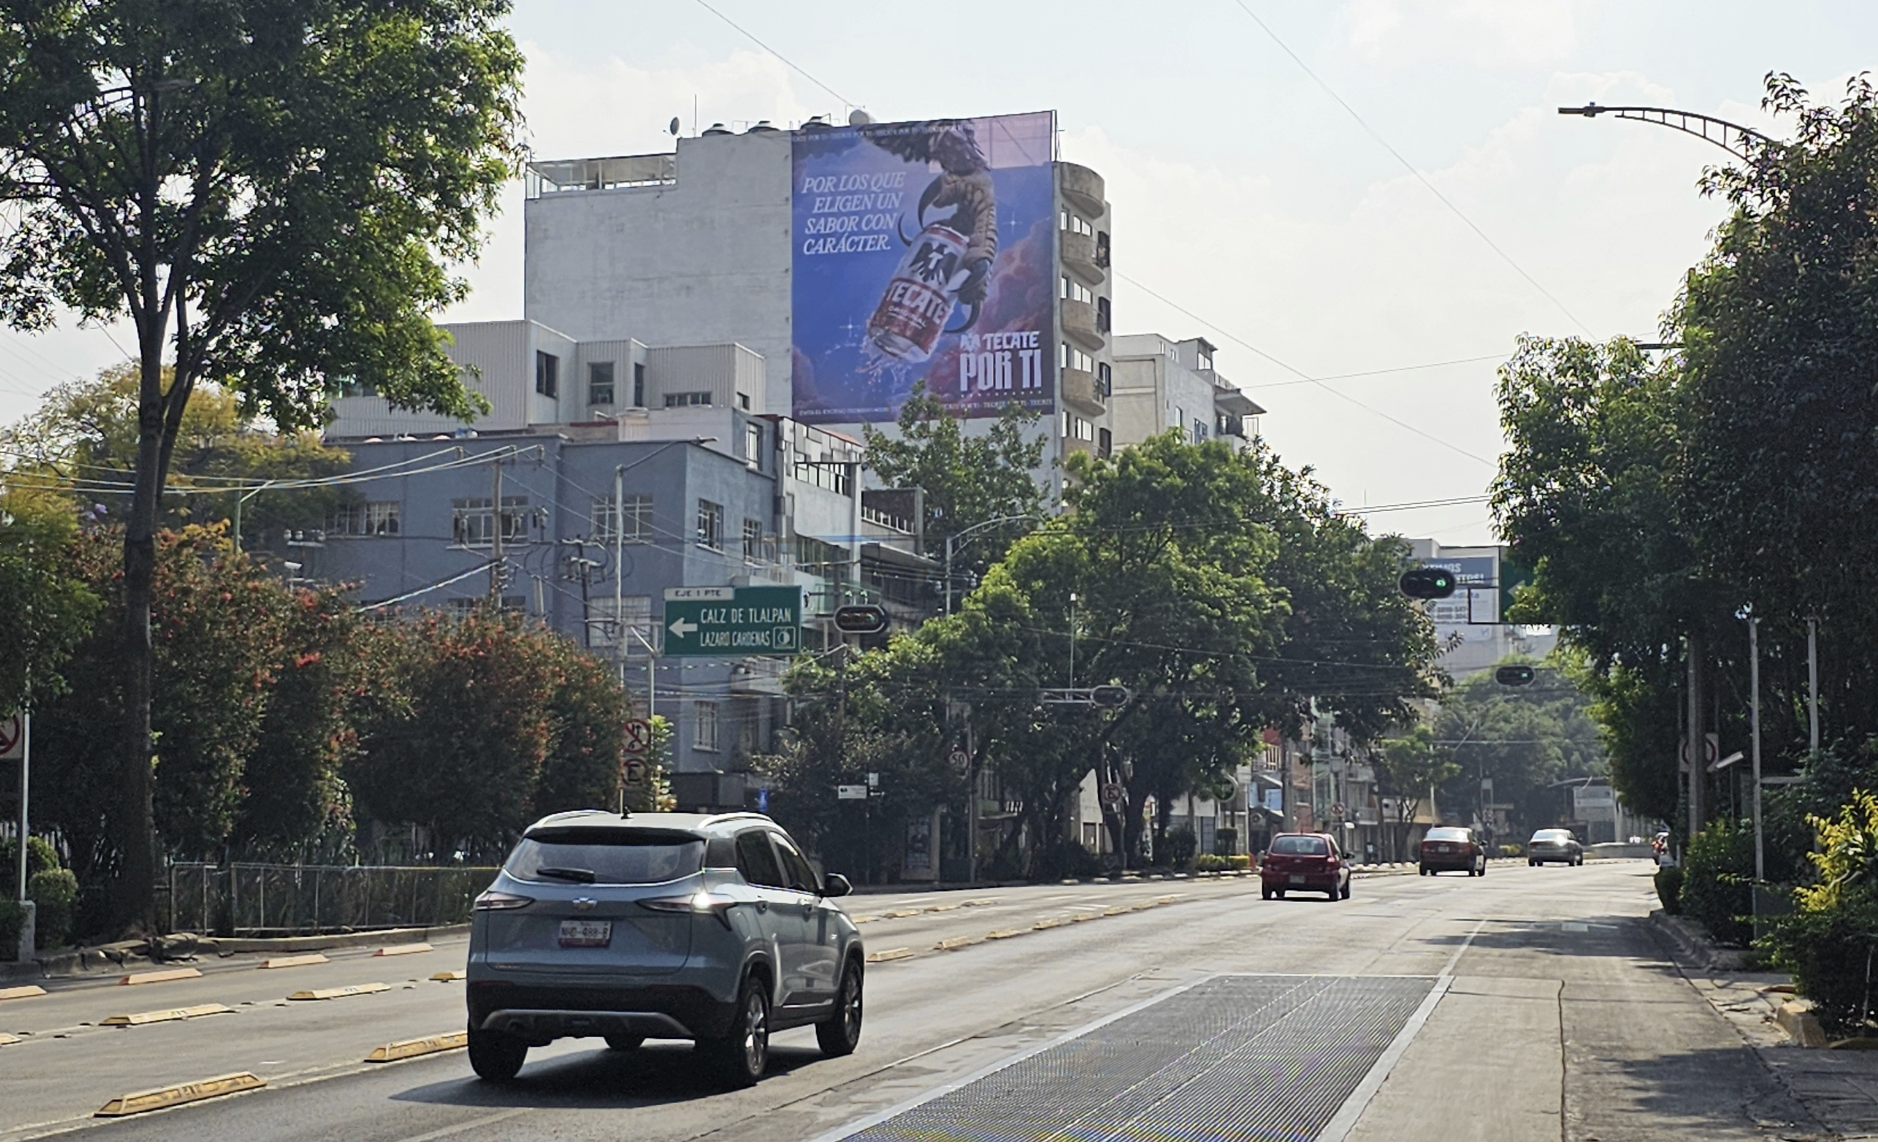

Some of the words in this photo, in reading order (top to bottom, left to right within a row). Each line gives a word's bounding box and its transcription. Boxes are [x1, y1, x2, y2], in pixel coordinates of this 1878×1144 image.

[801, 176, 837, 194] POR
[838, 174, 870, 192] LOS
[871, 172, 906, 192] QUE
[812, 194, 875, 214] ELIGEN
[877, 192, 904, 210] UN
[805, 216, 859, 234] SABOR
[862, 213, 898, 231] CON
[803, 232, 891, 255] CARÁCTER.
[886, 282, 948, 324] TECATE
[982, 331, 1040, 350] TECATE
[960, 350, 1012, 391] POR
[1019, 349, 1042, 388] TI
[700, 608, 726, 624] CALZ
[731, 608, 744, 624] DE
[748, 608, 791, 624] TLALPAN
[700, 631, 730, 646] LAZARO
[732, 630, 770, 646] CARDENAS
[952, 754, 964, 765] 50
